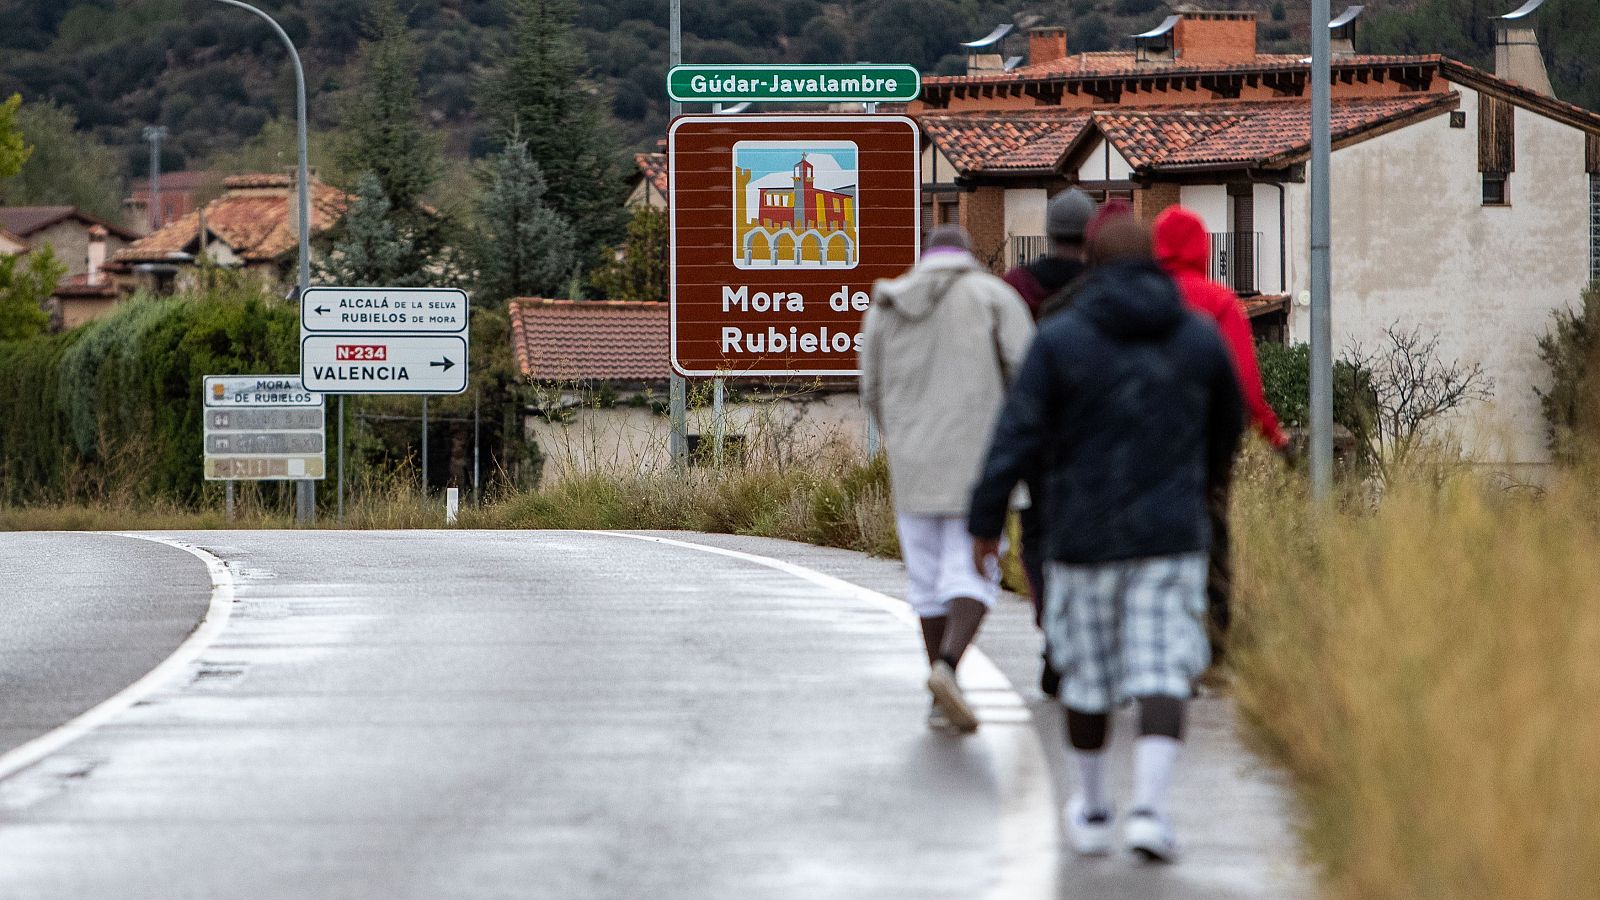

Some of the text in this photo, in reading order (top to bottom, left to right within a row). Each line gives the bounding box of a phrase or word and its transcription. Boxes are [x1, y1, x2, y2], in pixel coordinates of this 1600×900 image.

[690, 74, 898, 93] Gúdar-Javalambre
[339, 297, 456, 309] ALCALÁ DE LA SELVA
[722, 285, 870, 312] Mora de
[341, 313, 407, 323] RUBIELOS
[721, 326, 865, 353] Rubielos
[337, 347, 385, 360] N-234
[313, 366, 410, 380] VALENCIA
[256, 380, 291, 390] MORA
[235, 392, 311, 403] DE RUBIELOS
